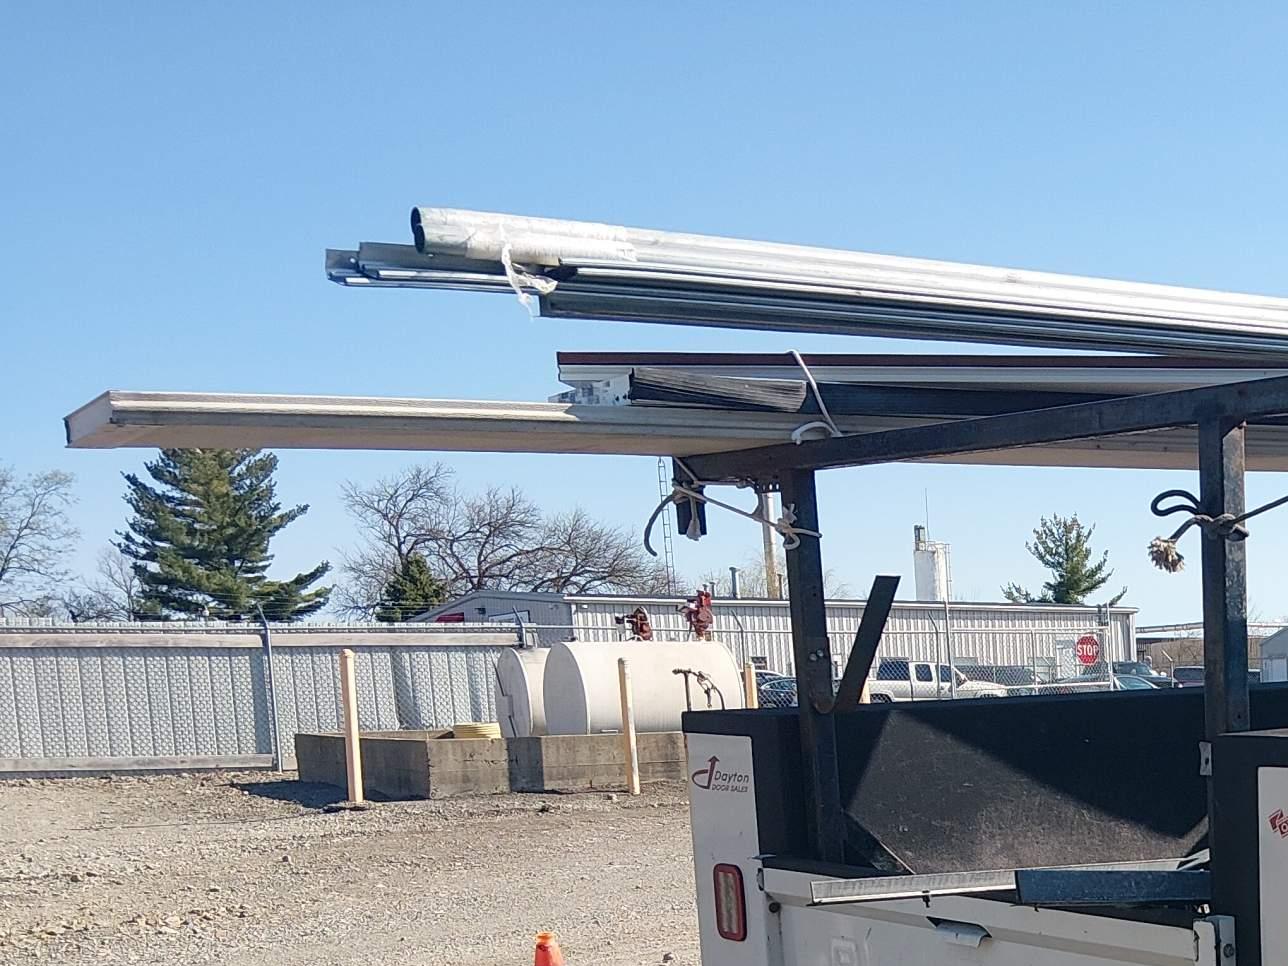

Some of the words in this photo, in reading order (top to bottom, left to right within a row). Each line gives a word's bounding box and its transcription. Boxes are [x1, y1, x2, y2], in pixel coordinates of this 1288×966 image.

[1077, 644, 1098, 656] STOP
[714, 770, 750, 784] Dayton
[712, 784, 729, 792] DOOR
[730, 784, 748, 793] SALES
